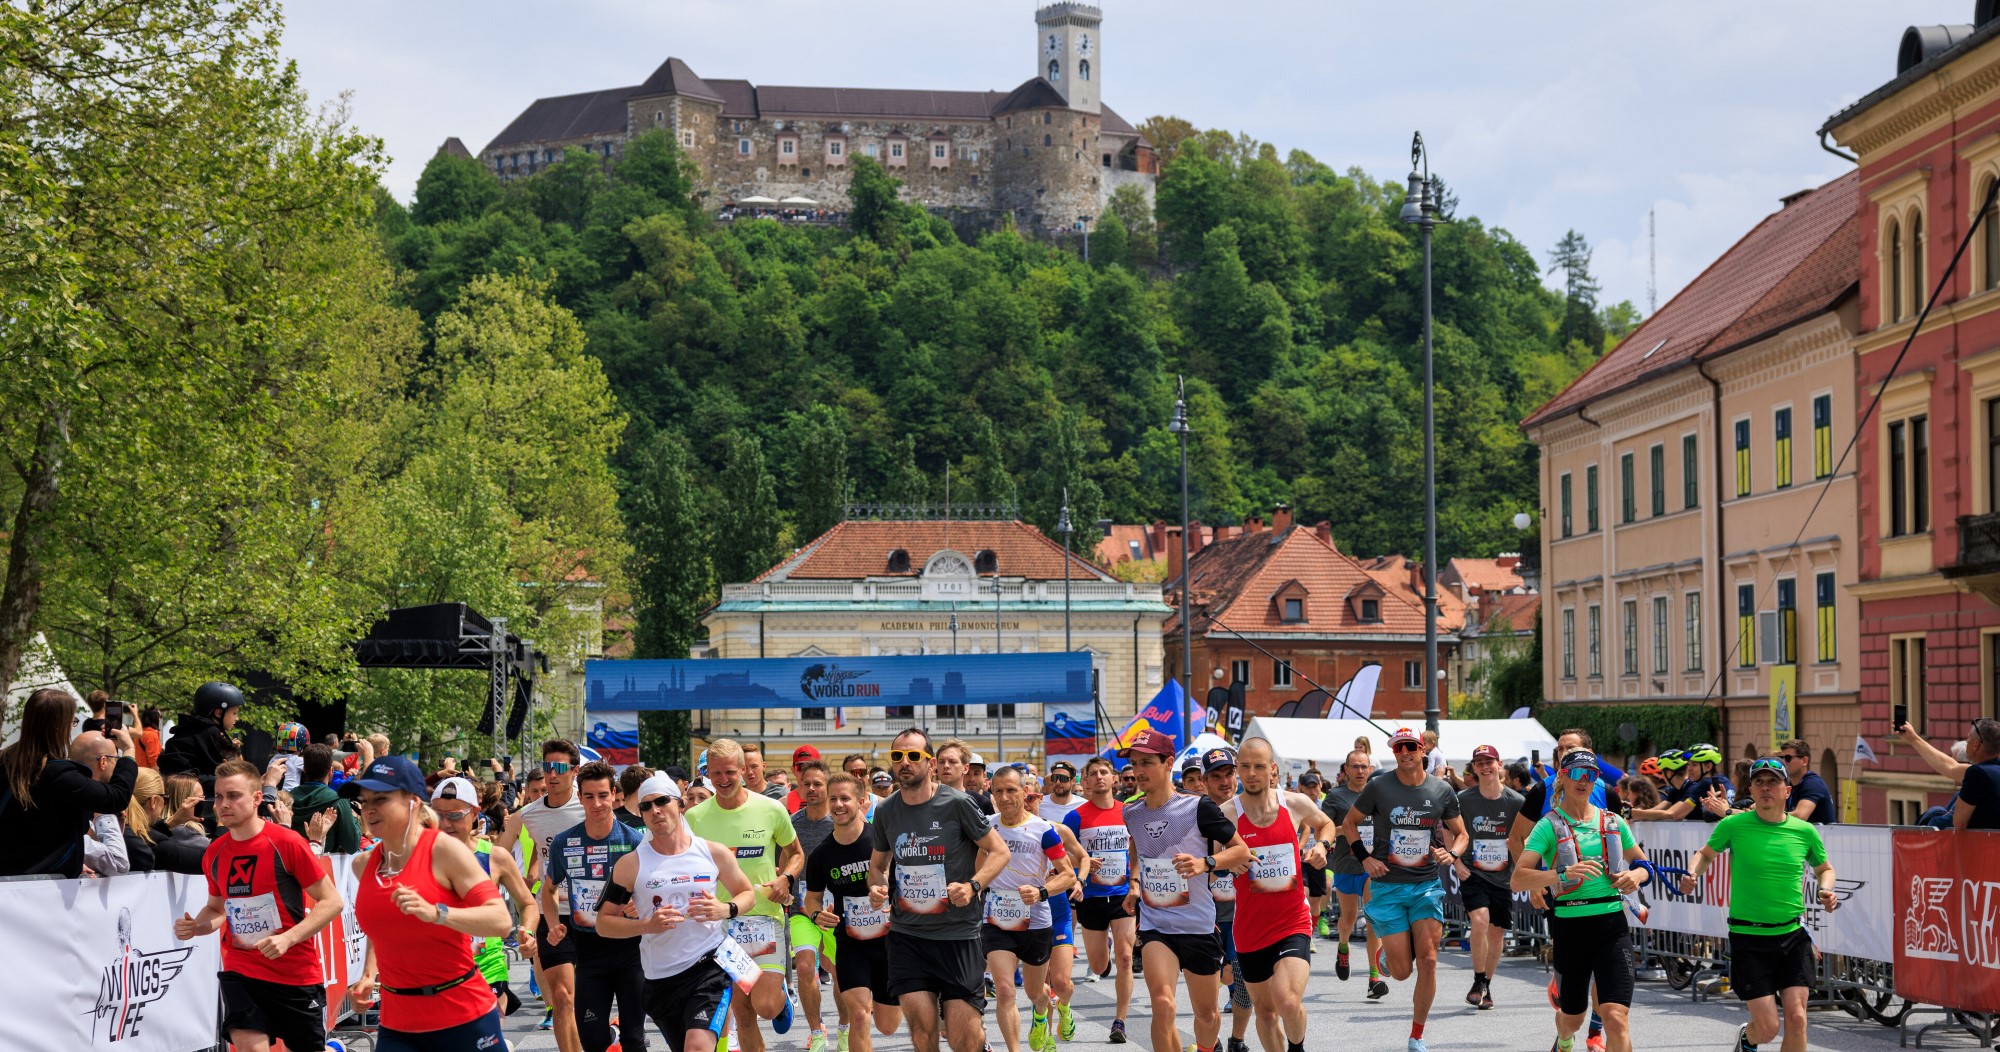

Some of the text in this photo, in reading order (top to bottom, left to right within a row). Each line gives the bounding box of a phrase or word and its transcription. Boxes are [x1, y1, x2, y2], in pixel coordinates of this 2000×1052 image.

[937, 583, 963, 592] 1701
[880, 621, 1020, 631] ACADEMIA PHILARMONICRUM
[1146, 706, 1174, 723] Bull
[1397, 817, 1421, 826] WORLD
[1087, 837, 1112, 850] ZWETTL
[738, 848, 764, 857] sport
[901, 845, 945, 858] WORLD RUN
[1395, 847, 1422, 856] 24594
[1479, 854, 1502, 862] 48196
[1097, 867, 1121, 876] 29190
[1256, 866, 1289, 880] 48816
[1145, 881, 1177, 893] 40845
[903, 888, 936, 899] 23794
[993, 908, 1021, 918] 19360
[851, 915, 881, 927] 53504
[235, 920, 270, 935] 52384
[736, 933, 766, 944] 53514
[104, 956, 161, 1002] WINGS
[108, 1002, 146, 1042] LIFE
